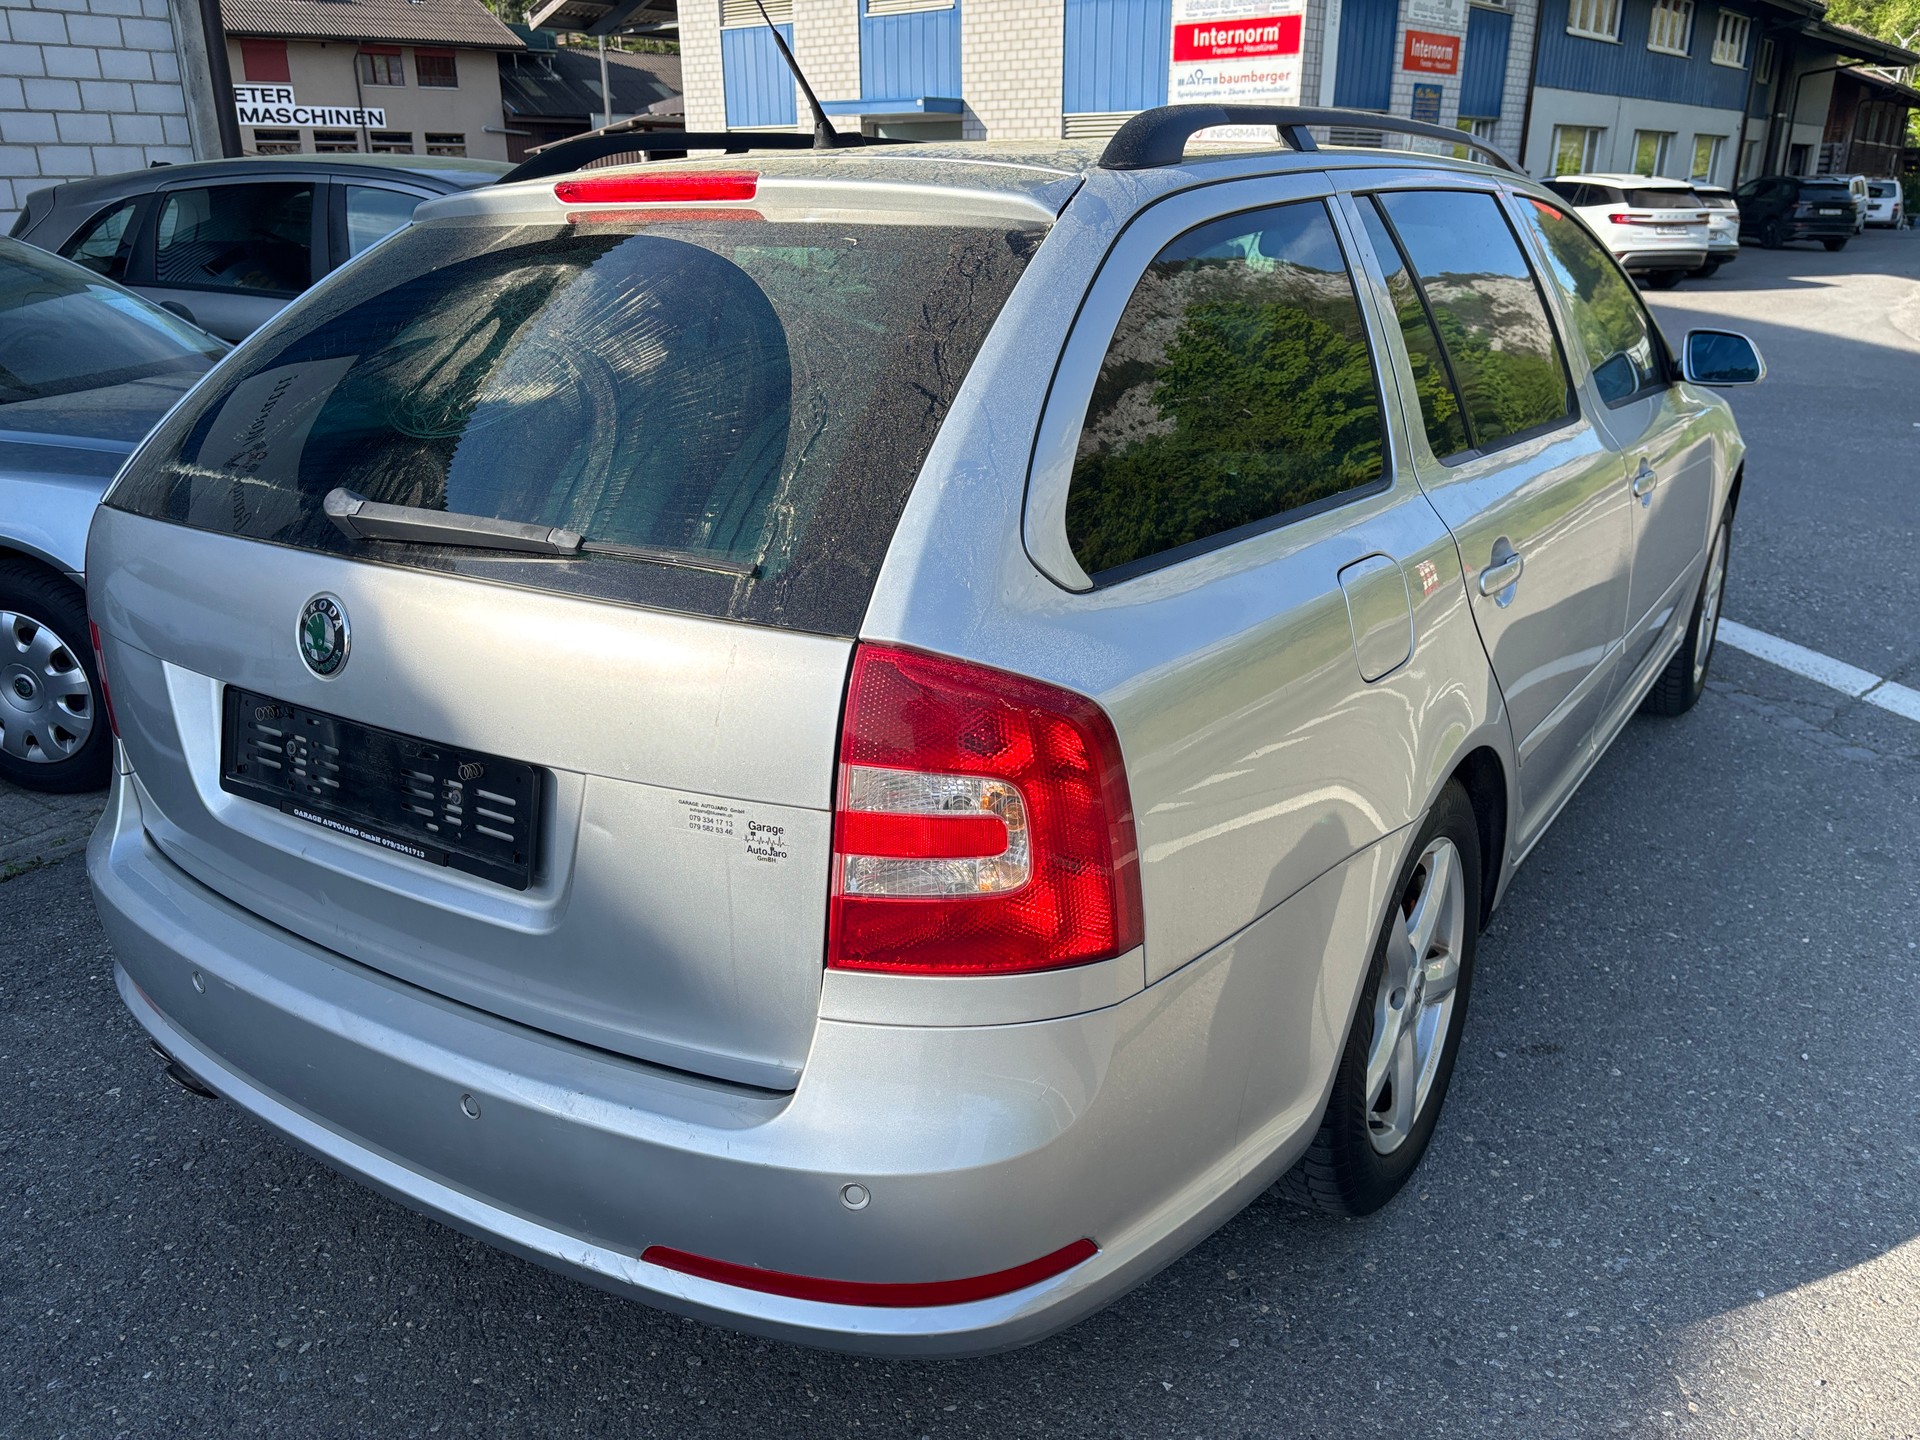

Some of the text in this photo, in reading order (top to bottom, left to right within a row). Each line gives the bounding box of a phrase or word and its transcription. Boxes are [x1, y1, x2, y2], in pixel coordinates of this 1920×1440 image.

[1193, 26, 1279, 47] Internorm
[1212, 44, 1278, 55] Fenster Haustüren
[1411, 38, 1453, 60] Internorm
[1219, 70, 1290, 84] baumberger
[239, 107, 384, 126] MASCHINEN
[678, 799, 699, 807] GARAGE
[701, 803, 728, 812] AUTOJARO
[689, 814, 733, 828] 079 334 17 13
[689, 822, 701, 830] 079
[702, 824, 714, 832] 582
[715, 826, 723, 834] 53
[748, 820, 784, 835] Garage
[293, 808, 425, 858] GARAGE AUTOJARO GmbH 079/3341713
[746, 845, 787, 858] AutoJaro
[757, 855, 777, 863] GmBH
